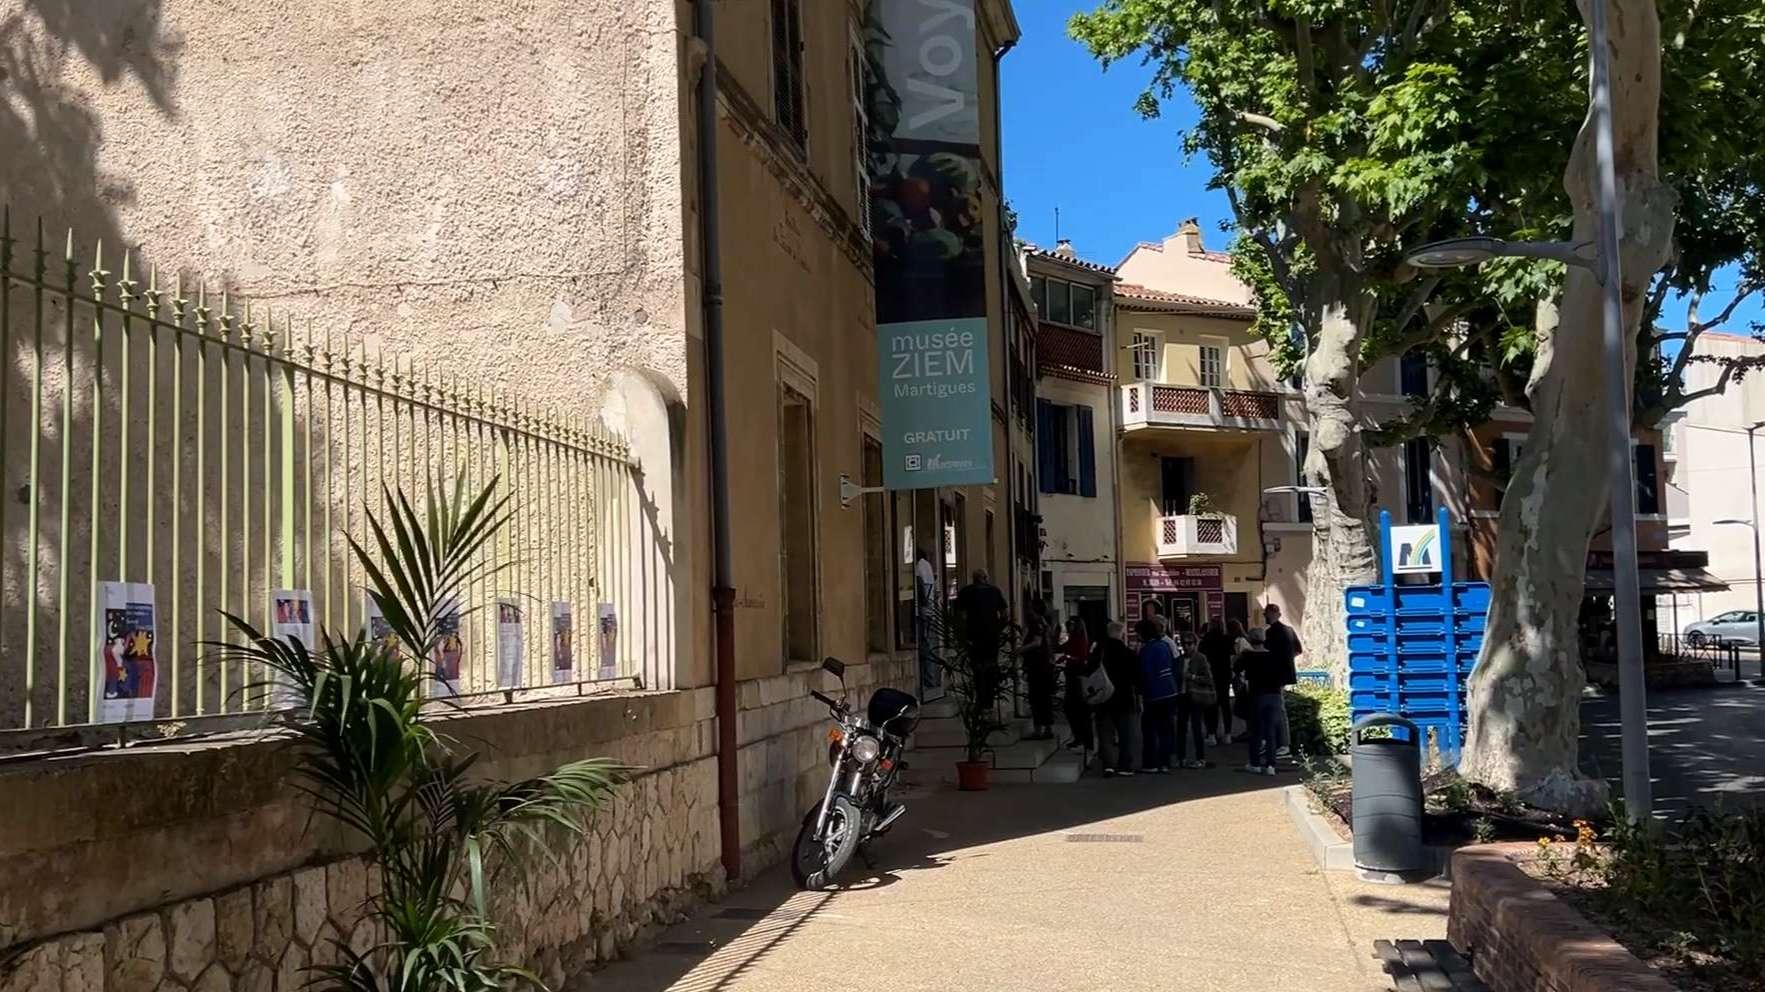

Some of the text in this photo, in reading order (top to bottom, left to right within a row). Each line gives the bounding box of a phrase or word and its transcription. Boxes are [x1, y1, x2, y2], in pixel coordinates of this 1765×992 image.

[891, 326, 974, 352] musée
[891, 349, 974, 379] ZIEM
[894, 379, 976, 399] Martigues
[904, 428, 971, 444] GRATUIT
